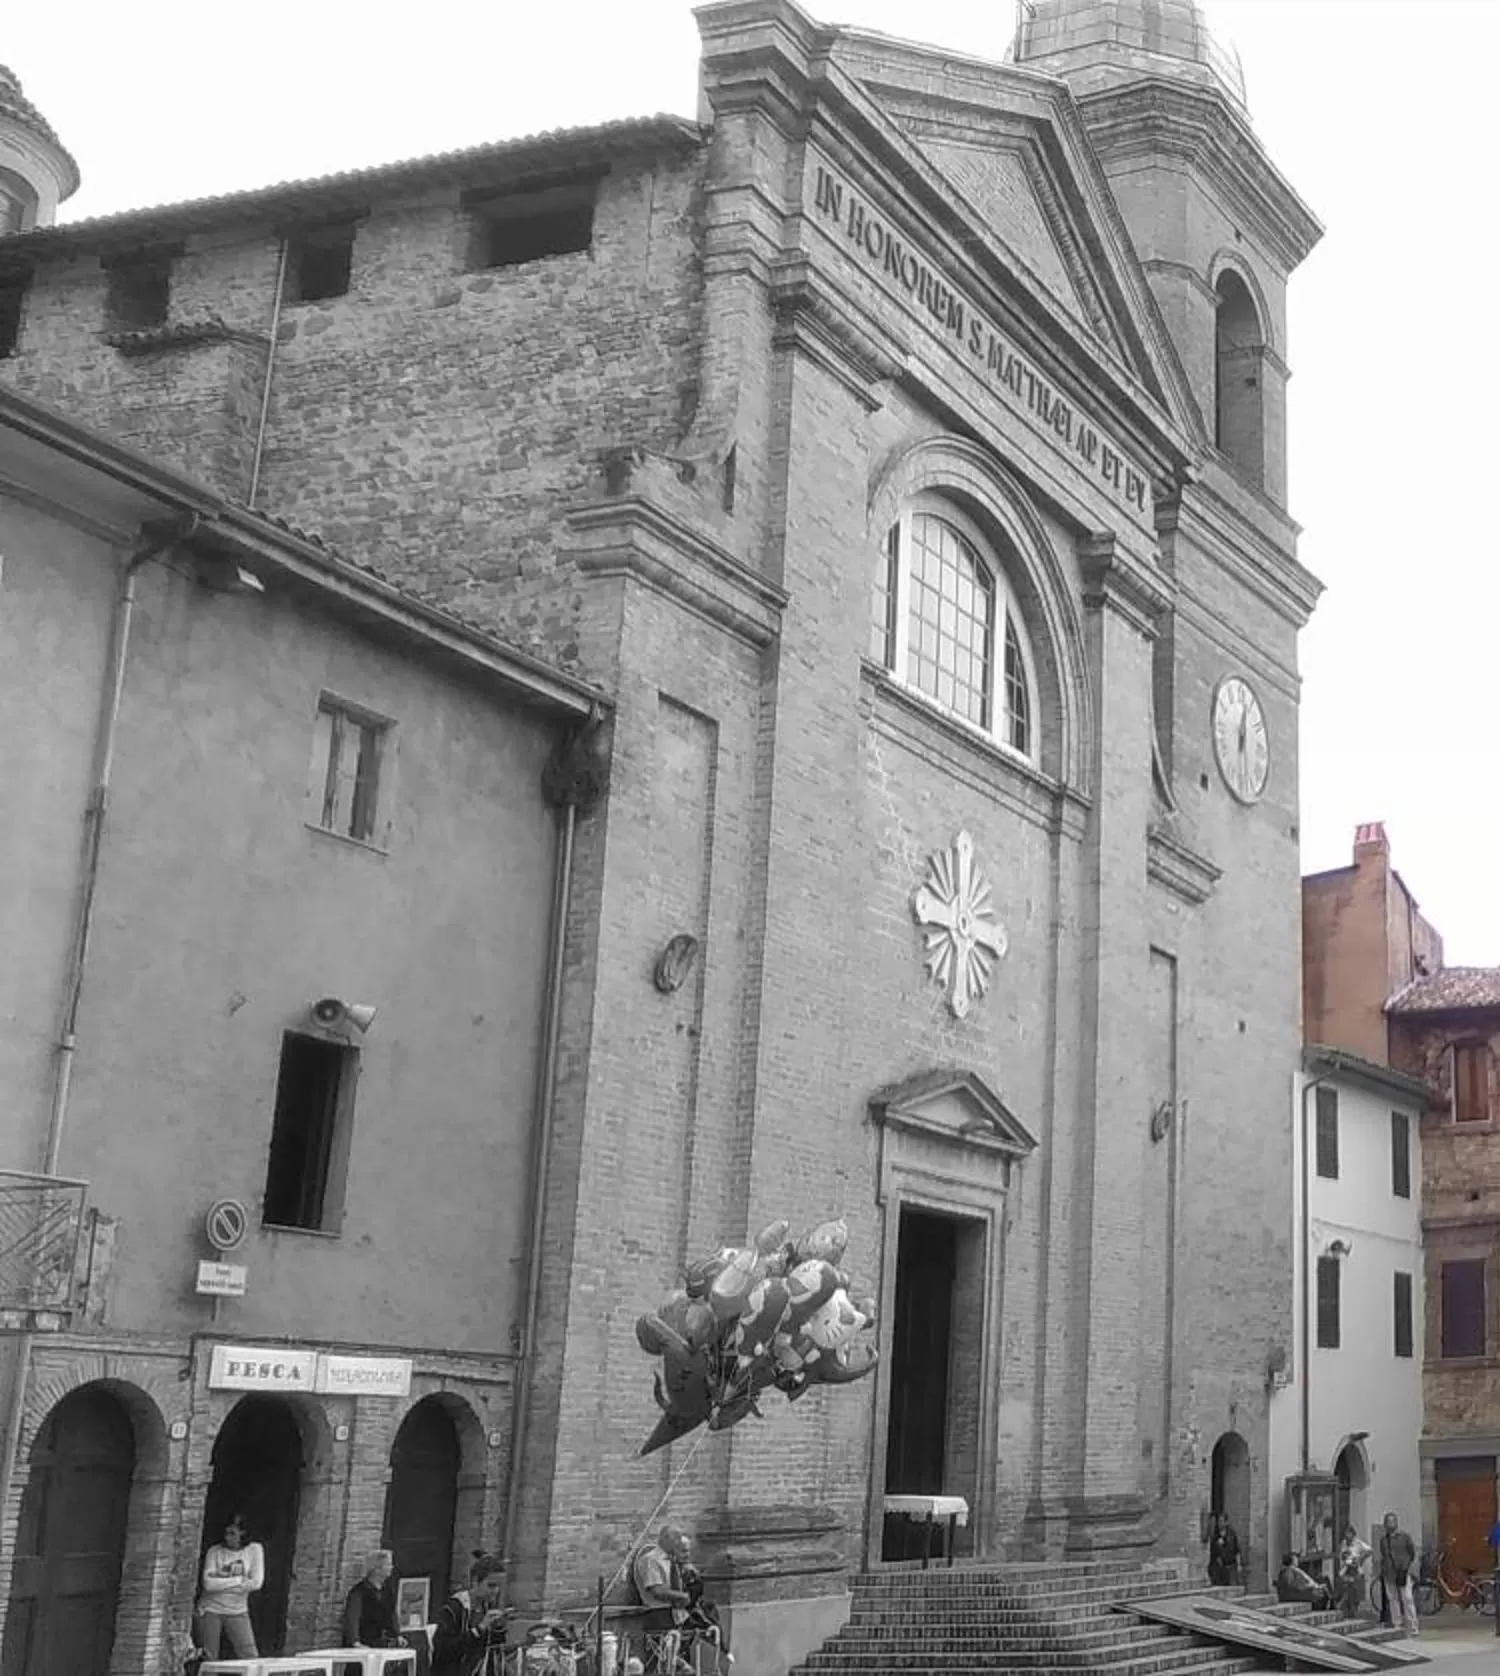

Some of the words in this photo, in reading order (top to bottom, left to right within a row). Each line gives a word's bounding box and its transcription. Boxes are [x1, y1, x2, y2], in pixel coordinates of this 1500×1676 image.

[815, 166, 842, 222] IN
[848, 198, 963, 339] HONOREM
[968, 319, 984, 360] S.
[1102, 444, 1124, 488] ET
[227, 1360, 301, 1381] PESCA
